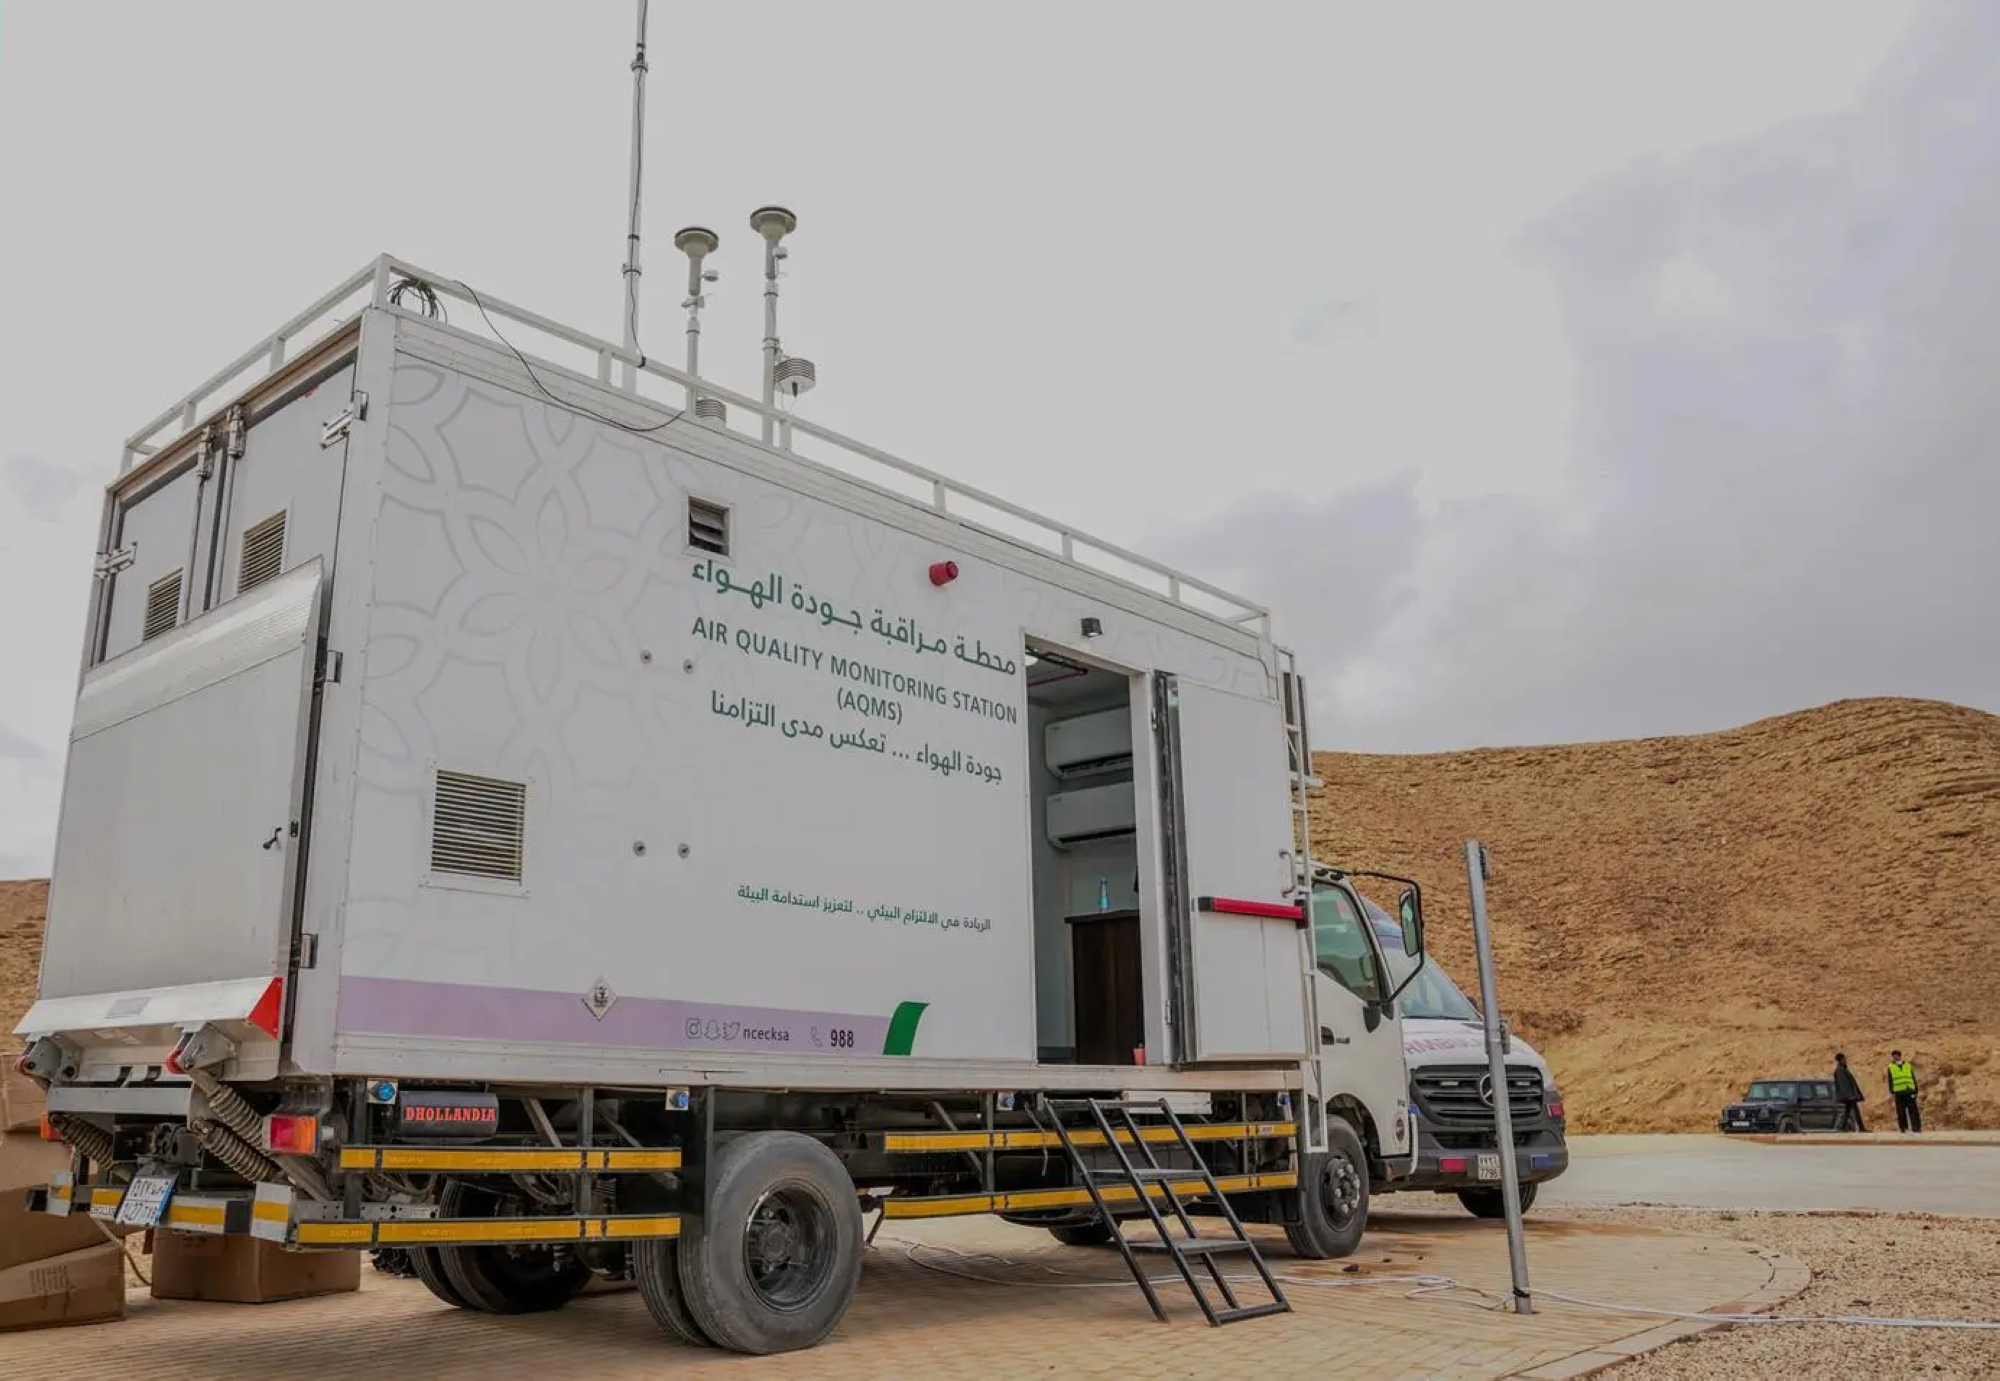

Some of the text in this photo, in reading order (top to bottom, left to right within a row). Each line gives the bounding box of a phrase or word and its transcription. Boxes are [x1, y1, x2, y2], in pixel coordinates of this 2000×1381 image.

[953, 634, 1016, 676] محطة
[692, 617, 1017, 724] AIR QUALITY MONITORING STATION
[712, 690, 775, 728] التزامنا
[837, 687, 903, 725] (AQMS)
[781, 719, 824, 738] مدى
[829, 728, 887, 753] تعكس
[916, 743, 962, 776] الهواء
[966, 755, 1003, 786] جودة
[737, 884, 769, 903] البيئة
[772, 889, 820, 908] استدامة
[867, 903, 900, 922] البيئي
[903, 909, 939, 925] الالتزام
[941, 918, 961, 931] في
[963, 917, 991, 932] الريادة
[743, 1027, 855, 1048] ncecksa 988
[405, 1106, 497, 1121] DHOLLANDIA
